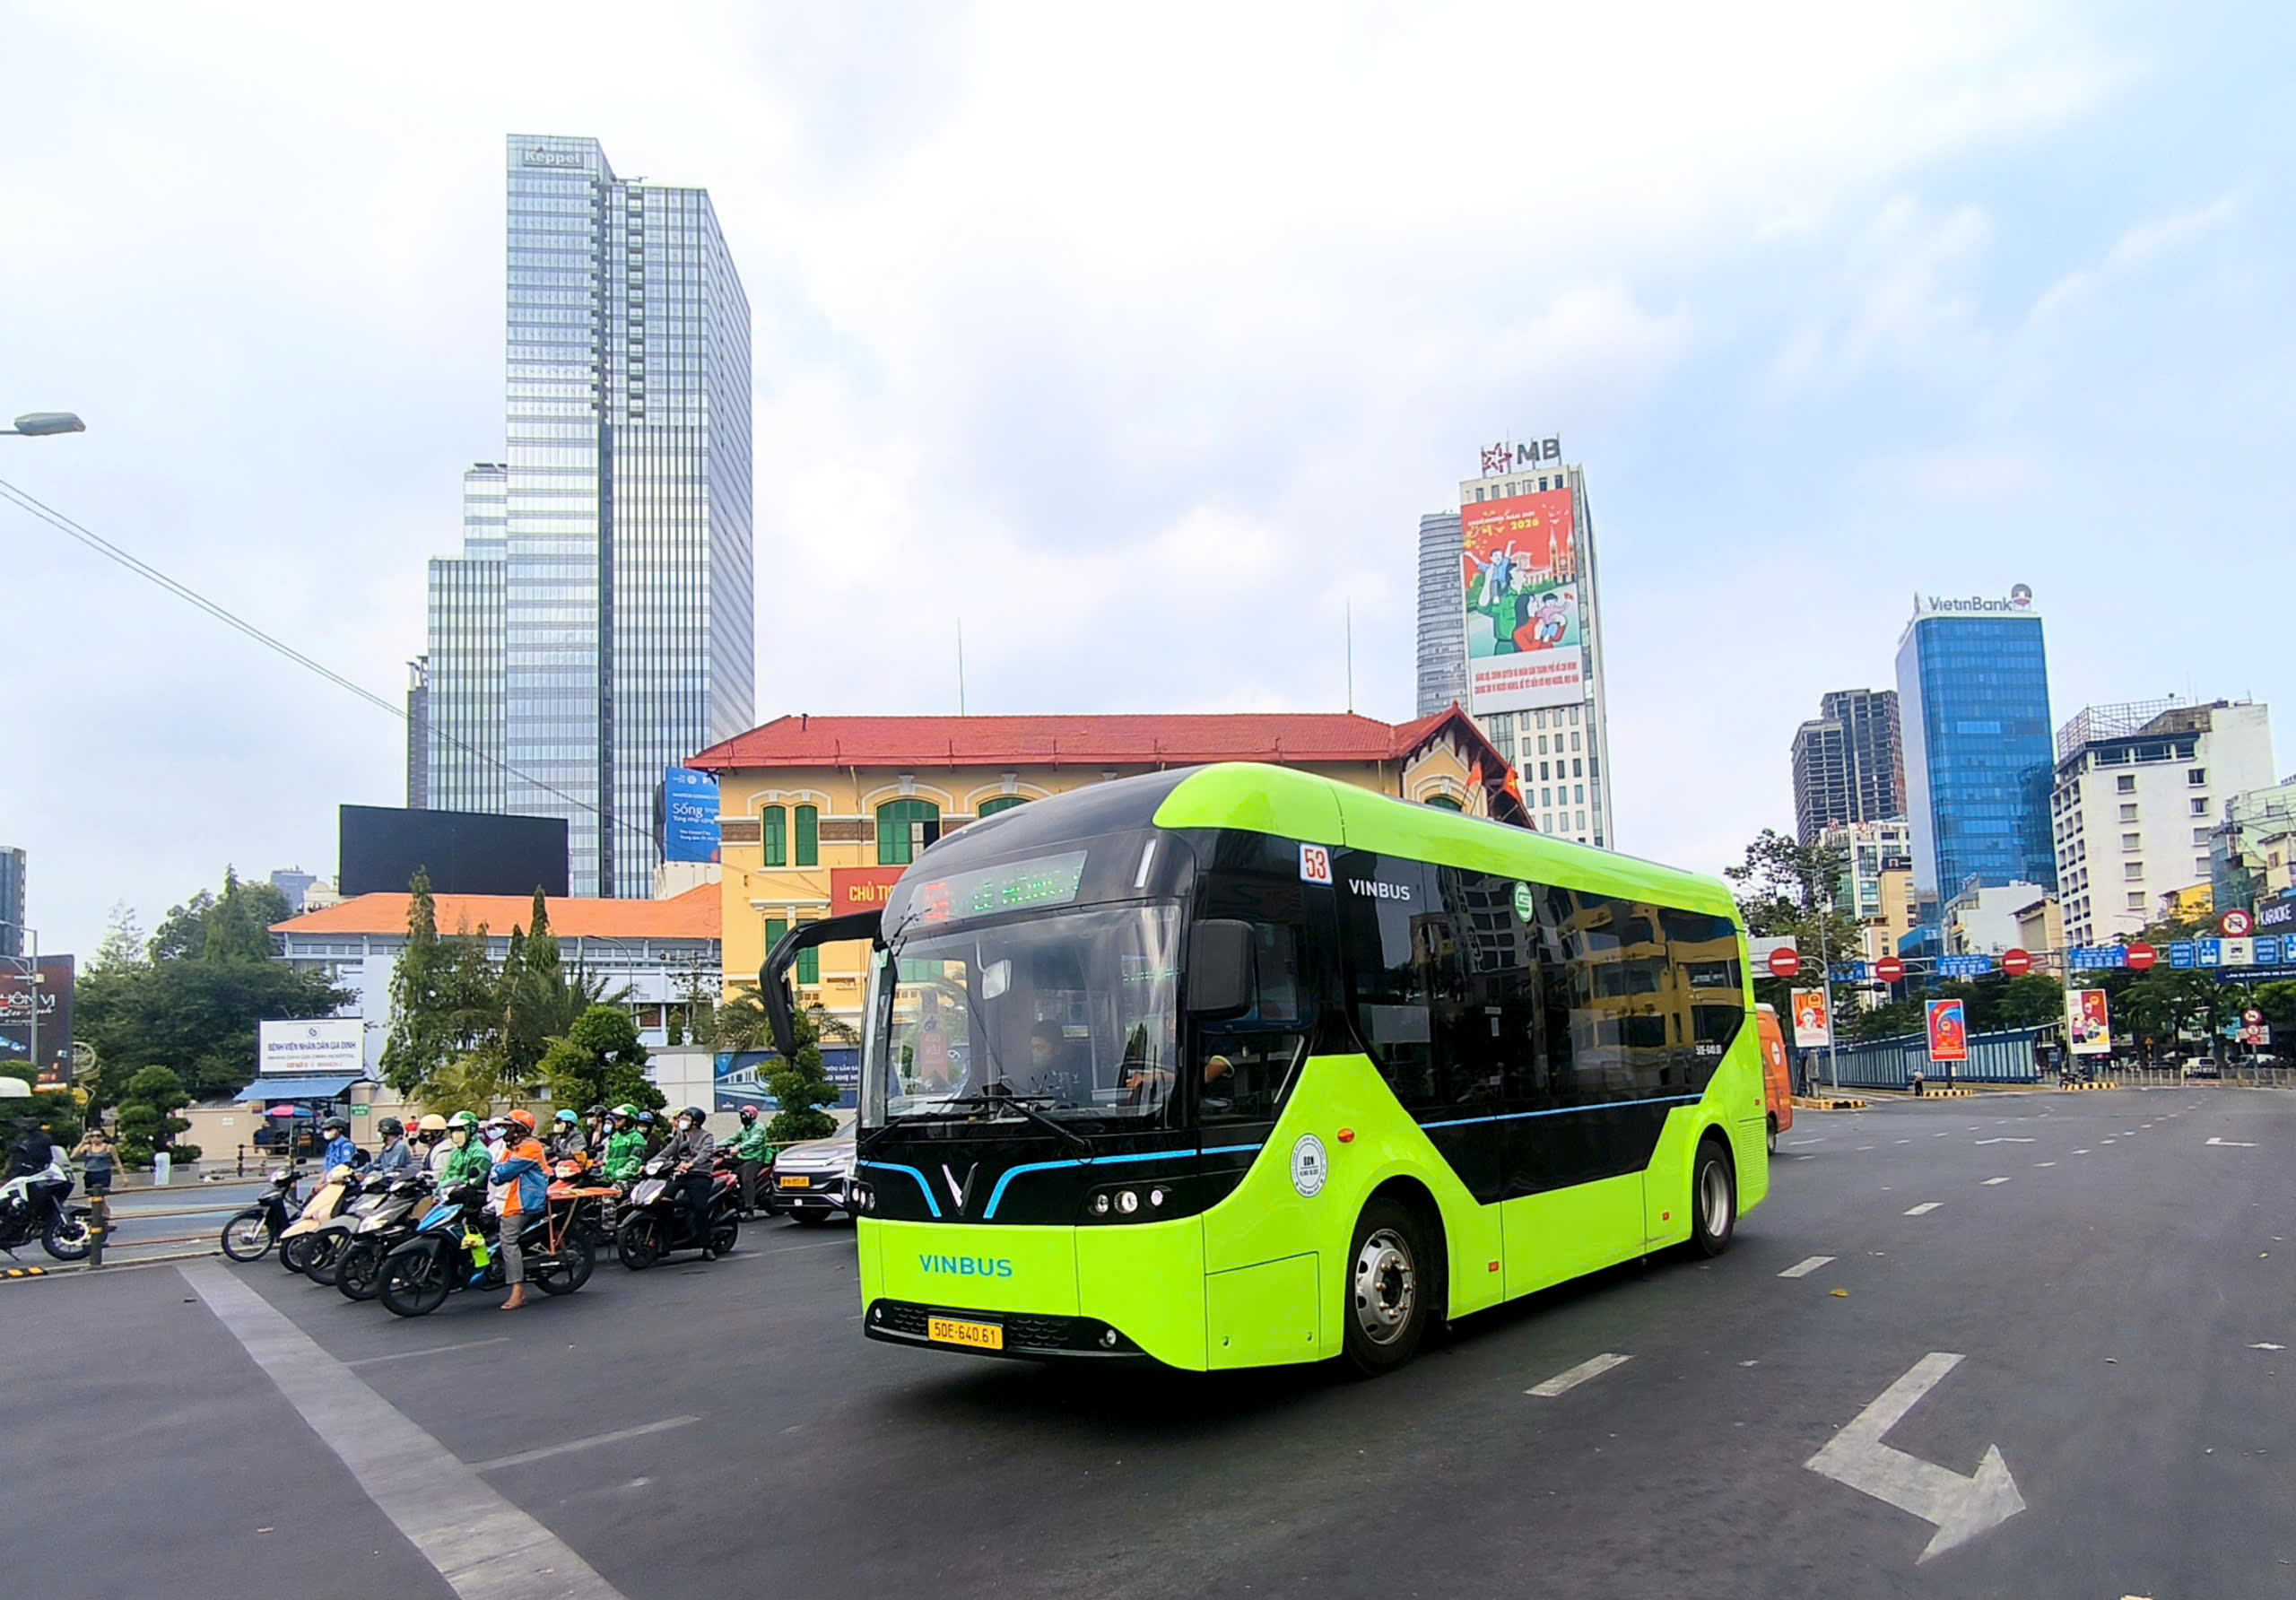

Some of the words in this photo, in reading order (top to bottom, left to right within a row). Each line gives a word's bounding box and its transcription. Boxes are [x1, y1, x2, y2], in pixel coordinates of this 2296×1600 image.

[524, 151, 580, 165] Keppel
[1517, 439, 1561, 465] MB
[1928, 596, 2013, 611] VietinBank
[673, 801, 703, 818] Sống
[1304, 848, 1326, 879] 53
[848, 880, 875, 902] CHỦ
[1348, 878, 1411, 901] VINBUS
[918, 1254, 1013, 1277] VINBUS
